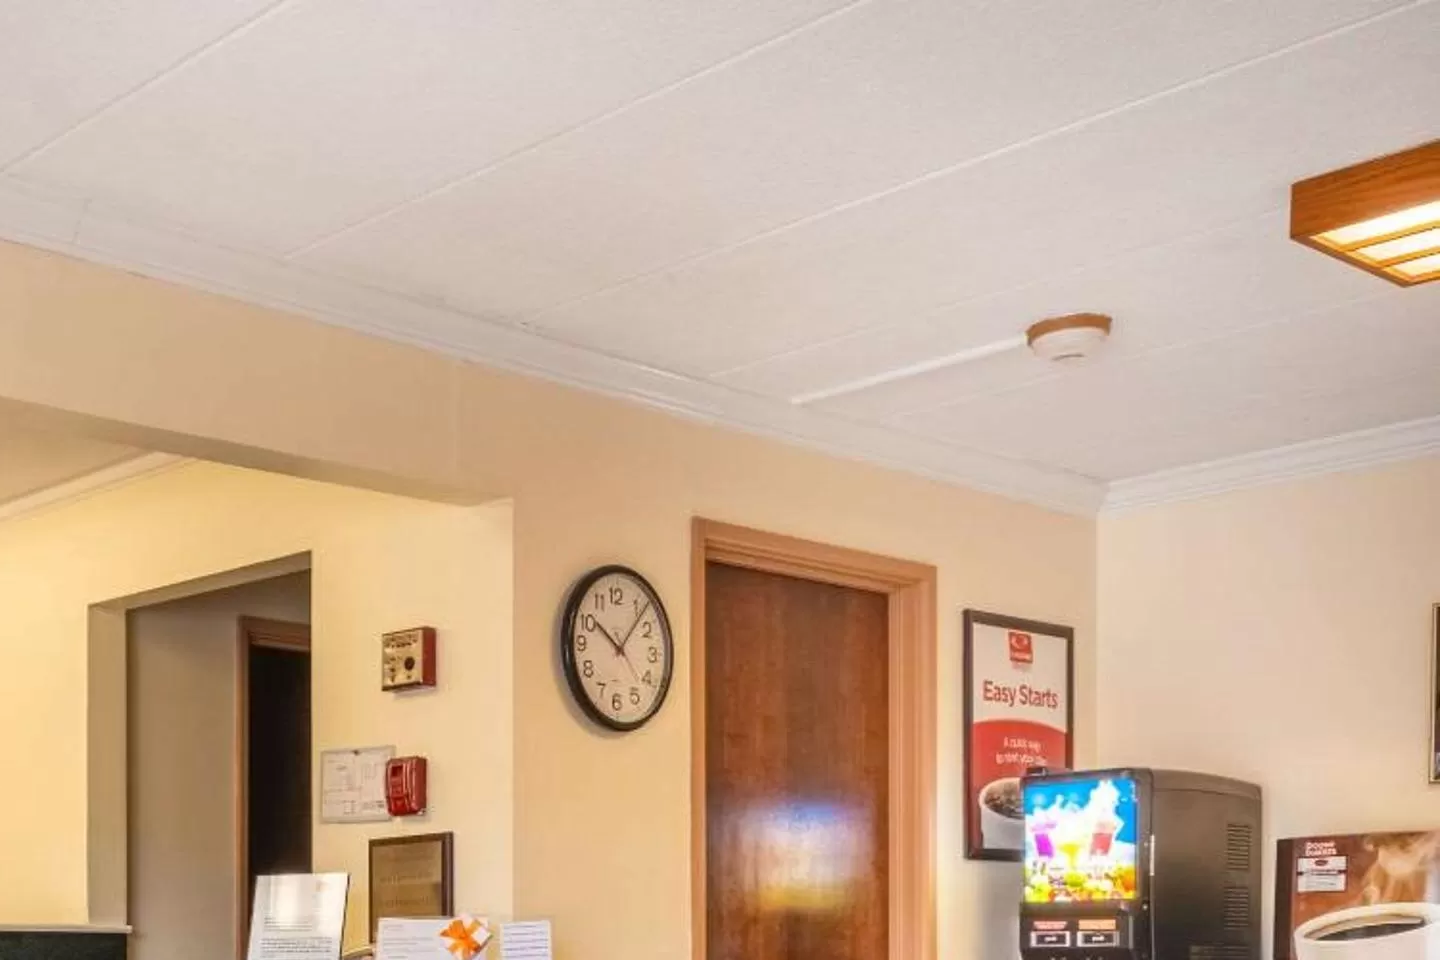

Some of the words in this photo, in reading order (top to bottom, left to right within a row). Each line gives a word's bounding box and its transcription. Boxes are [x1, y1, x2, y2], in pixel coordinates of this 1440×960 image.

[594, 593, 605, 612] 11
[609, 587, 623, 605] 12
[580, 614, 597, 632] 10
[642, 622, 652, 638] 2
[576, 635, 587, 651] 9
[647, 647, 658, 663] 3
[583, 660, 594, 678] 8
[641, 670, 652, 685] 4
[596, 681, 606, 698] 7
[629, 687, 640, 705] 5
[983, 680, 1017, 707] Easy
[1019, 685, 1058, 709] Starts
[612, 693, 622, 711] 6
